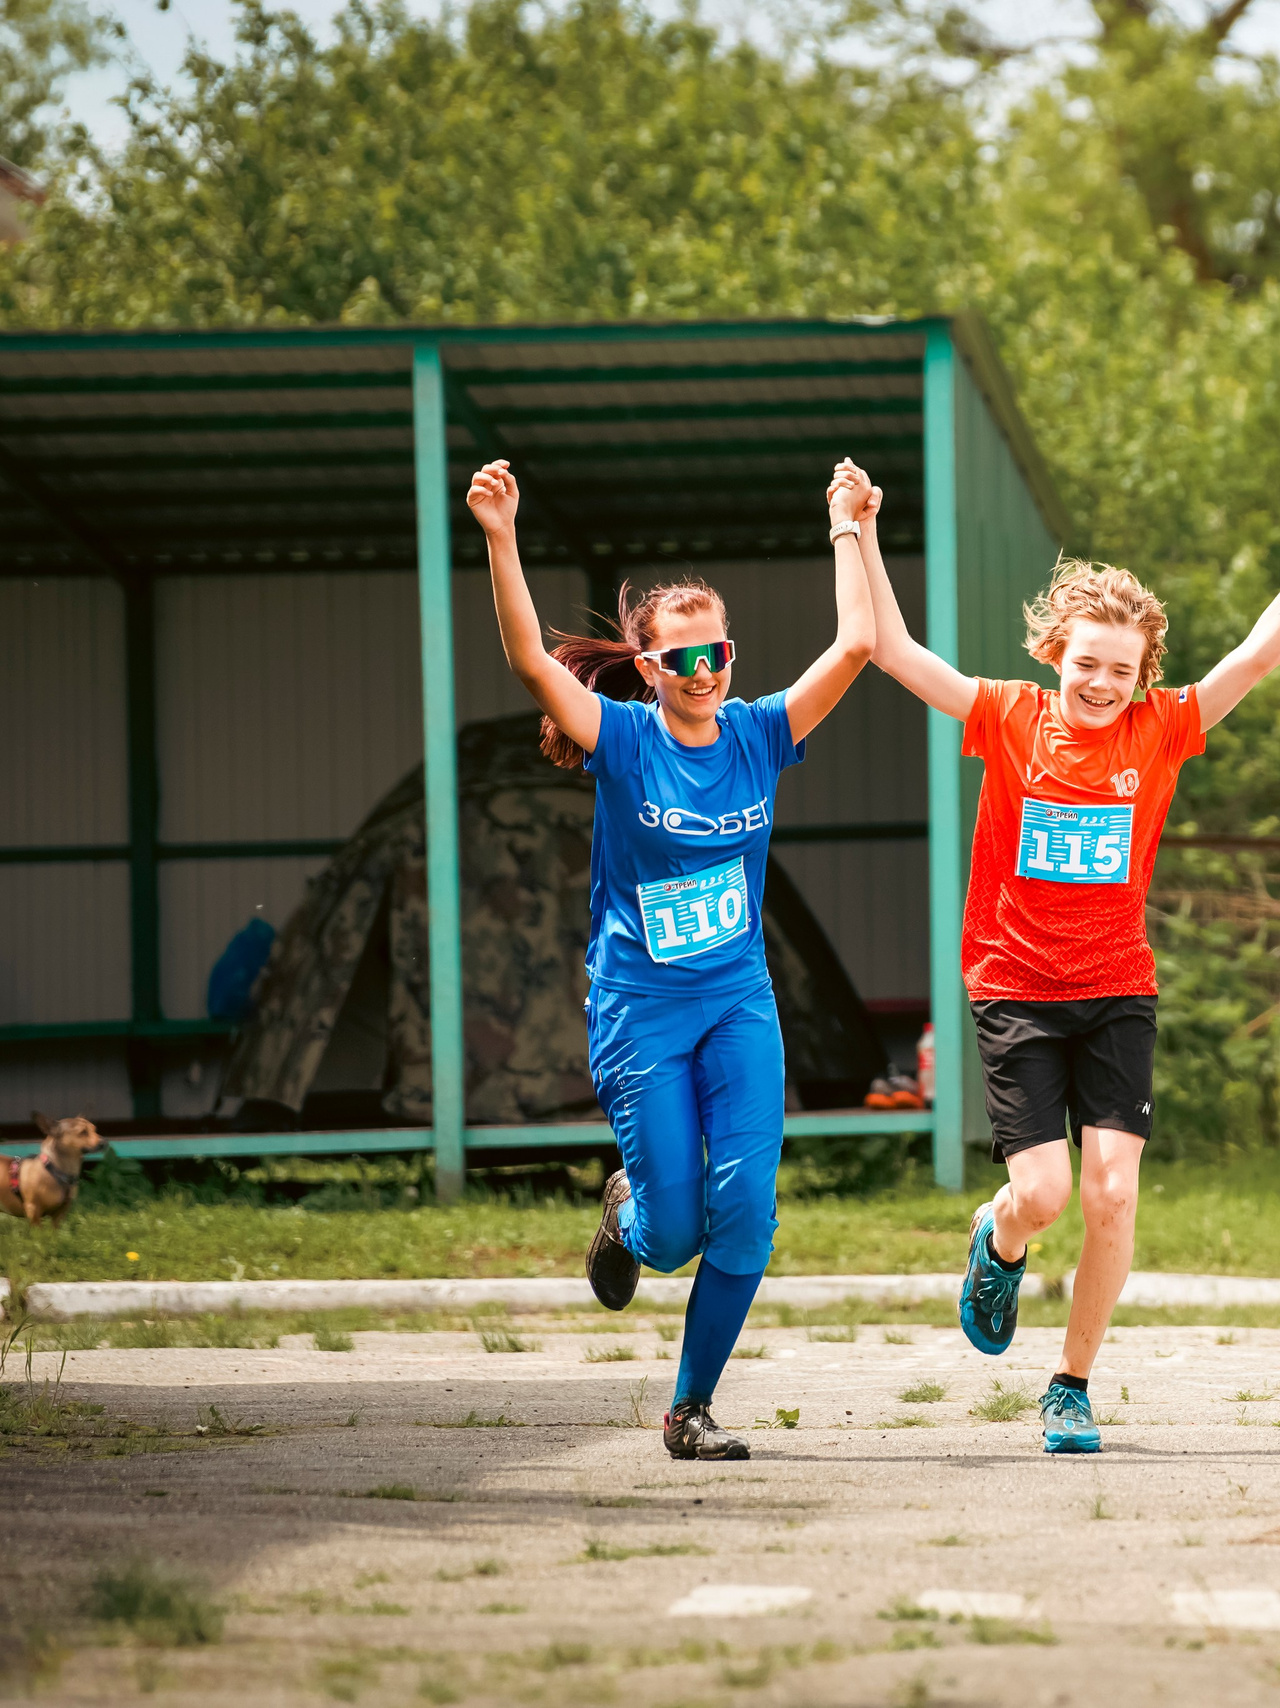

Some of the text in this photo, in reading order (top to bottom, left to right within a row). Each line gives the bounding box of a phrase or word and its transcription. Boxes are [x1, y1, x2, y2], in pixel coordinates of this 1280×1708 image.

[1110, 768, 1140, 797] 10
[1027, 830, 1122, 875] 115
[655, 888, 742, 949] 110
